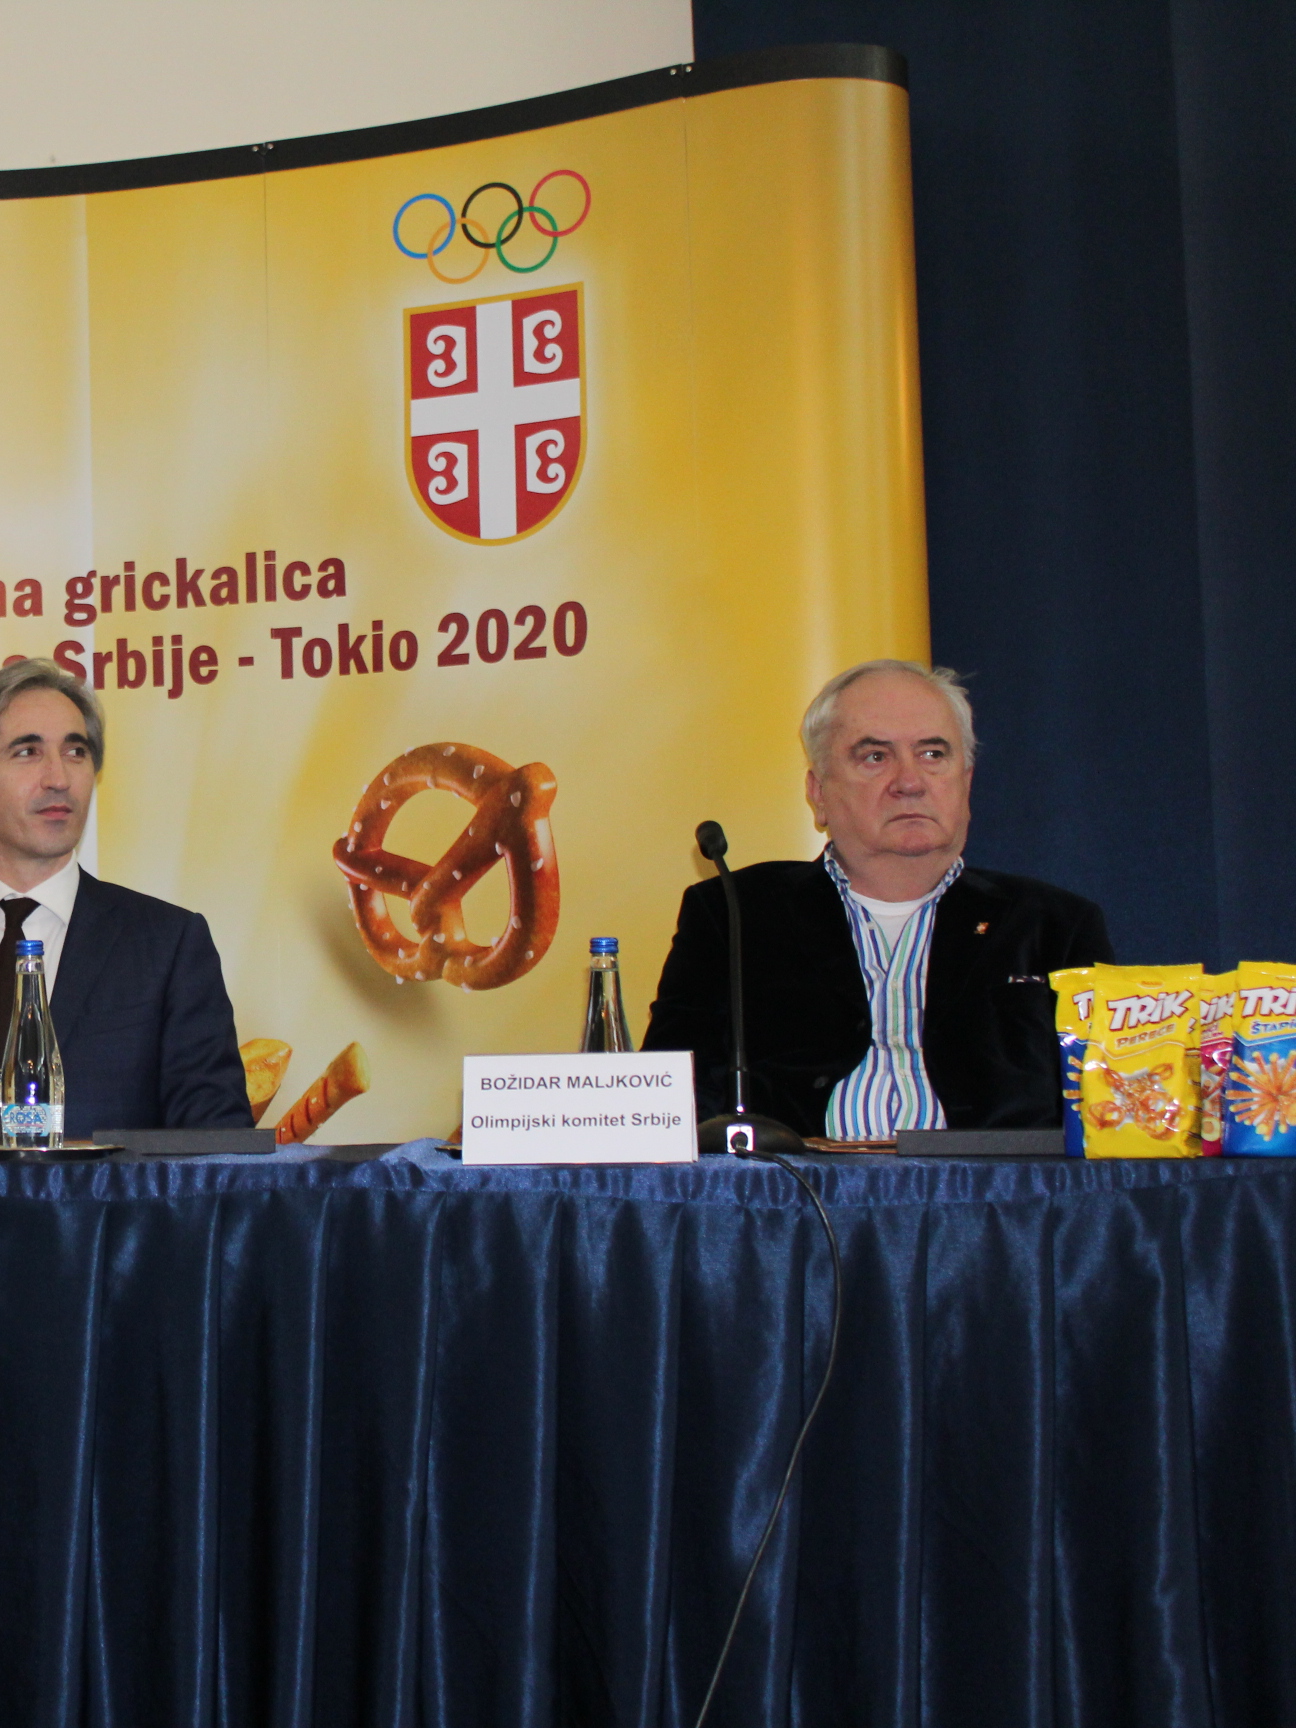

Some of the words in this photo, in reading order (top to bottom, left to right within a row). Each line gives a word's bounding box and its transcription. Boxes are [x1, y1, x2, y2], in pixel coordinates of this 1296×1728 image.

[63, 550, 347, 627] grickalica
[53, 634, 220, 699] Srbije
[238, 654, 254, 666] -
[271, 620, 419, 680] Tokio
[437, 601, 589, 667] 2020
[480, 1074, 561, 1090] BOŽIDAR
[567, 1071, 672, 1089] MALJKOVIĆ
[9, 1111, 43, 1124] ROSA
[471, 1115, 556, 1131] Olimpijski
[562, 1113, 625, 1127] komitet
[631, 1112, 681, 1129] Srbije
